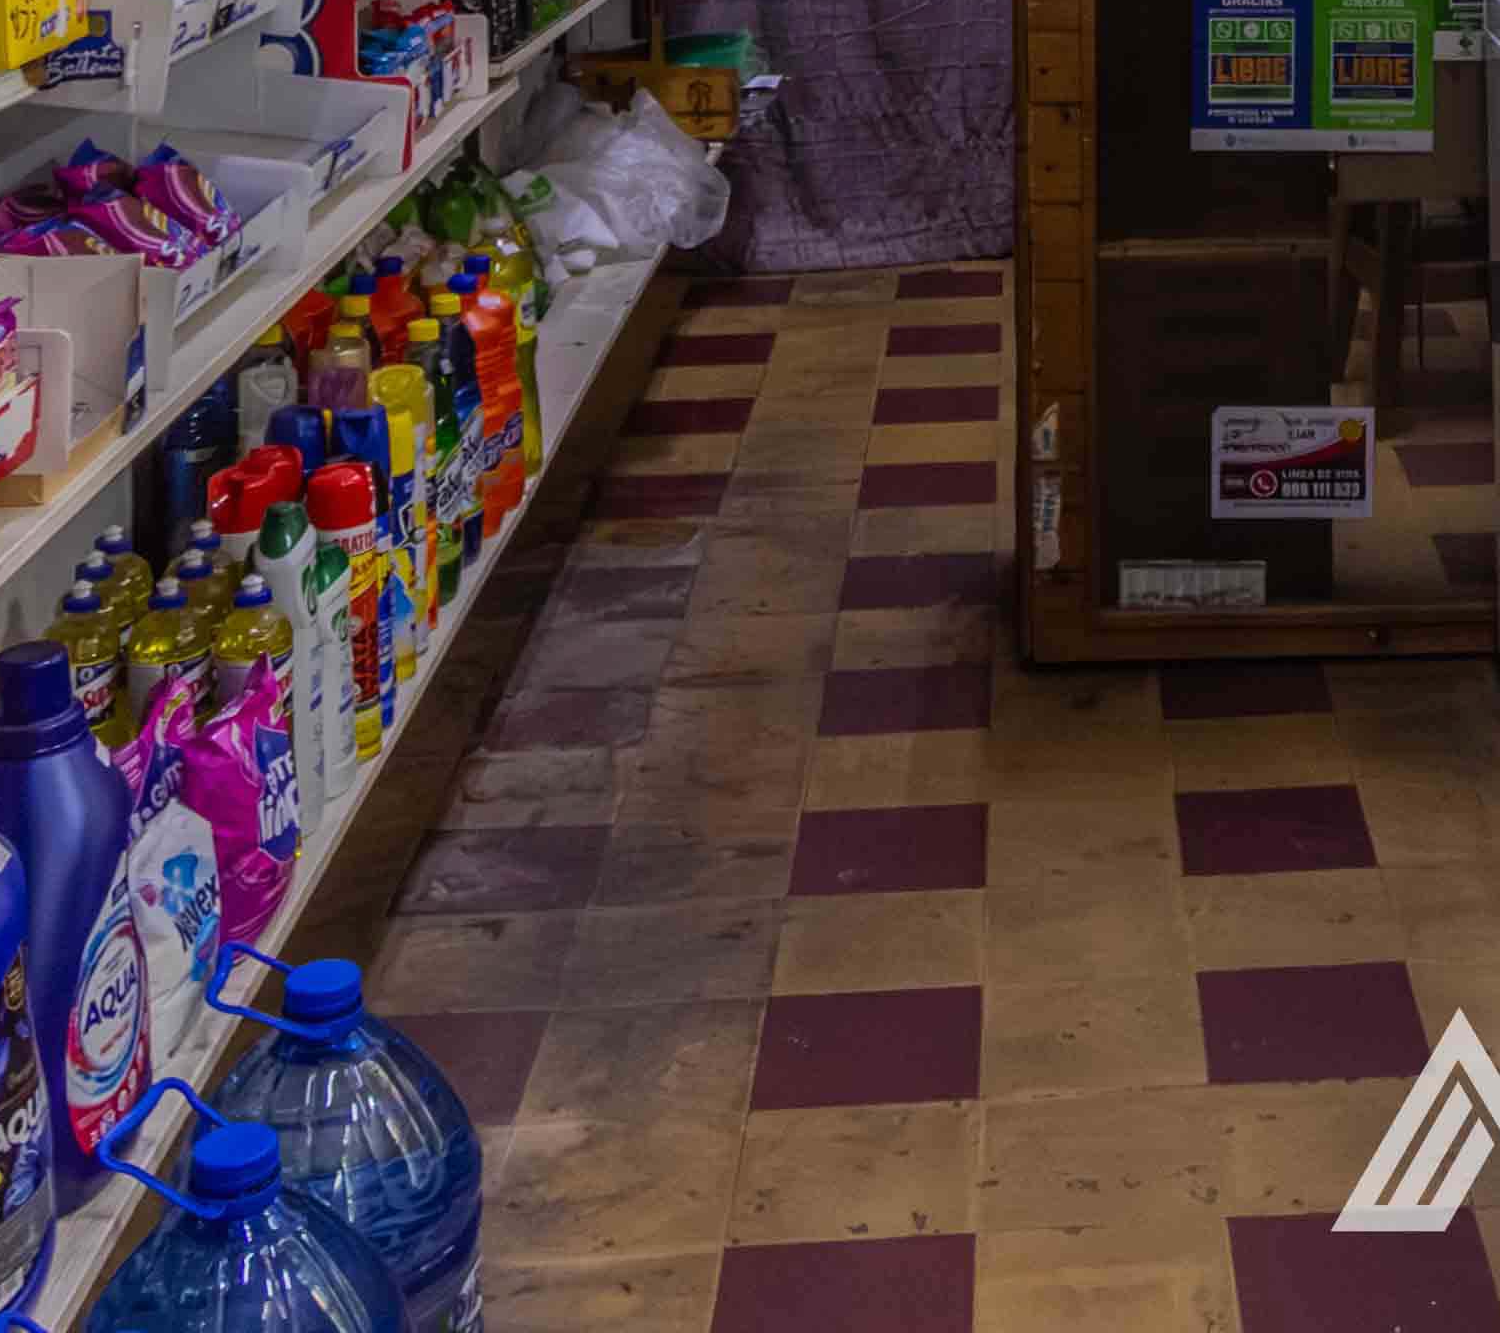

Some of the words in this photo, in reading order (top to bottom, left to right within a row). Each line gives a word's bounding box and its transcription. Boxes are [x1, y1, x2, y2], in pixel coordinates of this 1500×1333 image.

[1214, 55, 1291, 84] LIBRE
[1334, 57, 1413, 85] LIBRE
[81, 961, 139, 1035] AQUA
